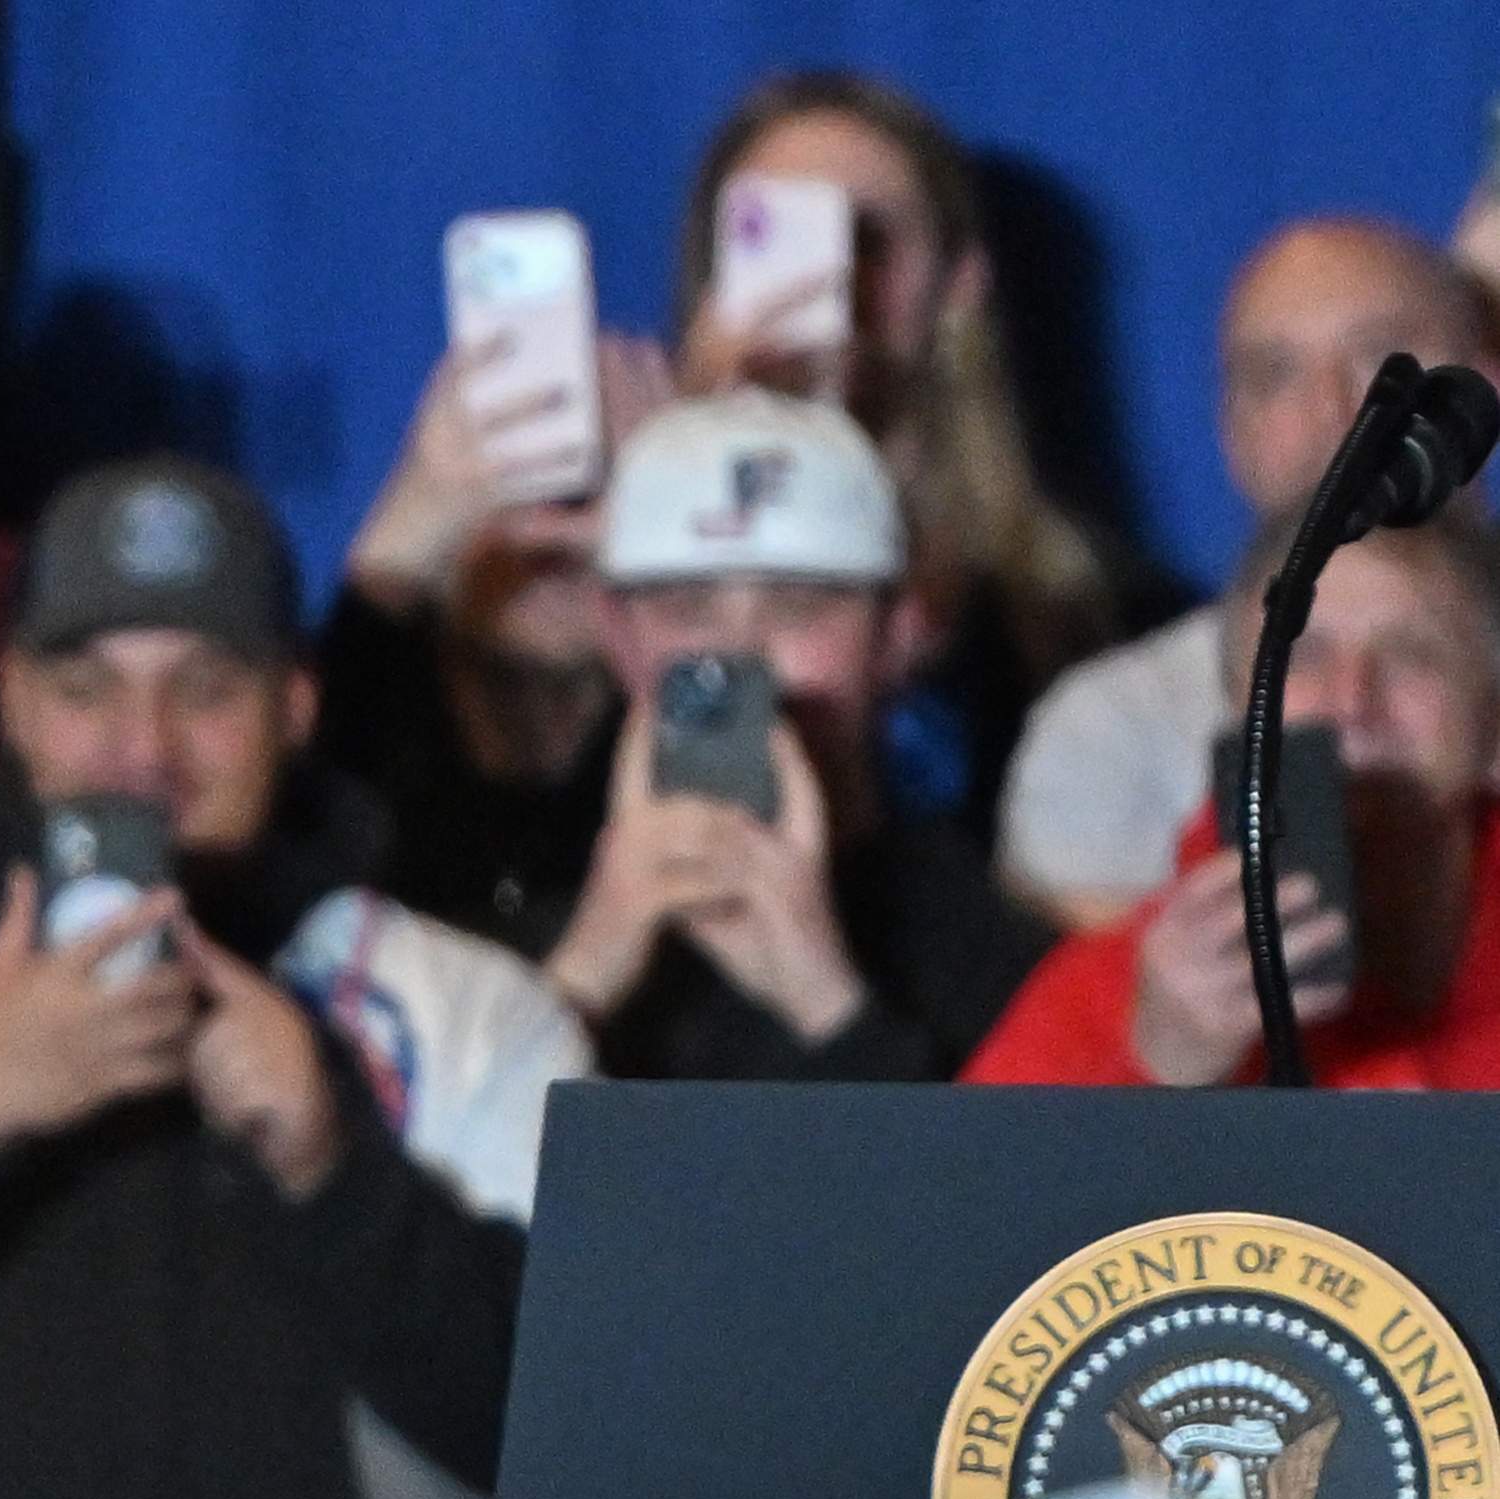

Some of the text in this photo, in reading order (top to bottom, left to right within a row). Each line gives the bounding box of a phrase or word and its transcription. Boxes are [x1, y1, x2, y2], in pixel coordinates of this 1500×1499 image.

[957, 1232, 1217, 1479] PRESIDENT
[1234, 1240, 1288, 1274] OF
[1300, 1254, 1368, 1310] THE
